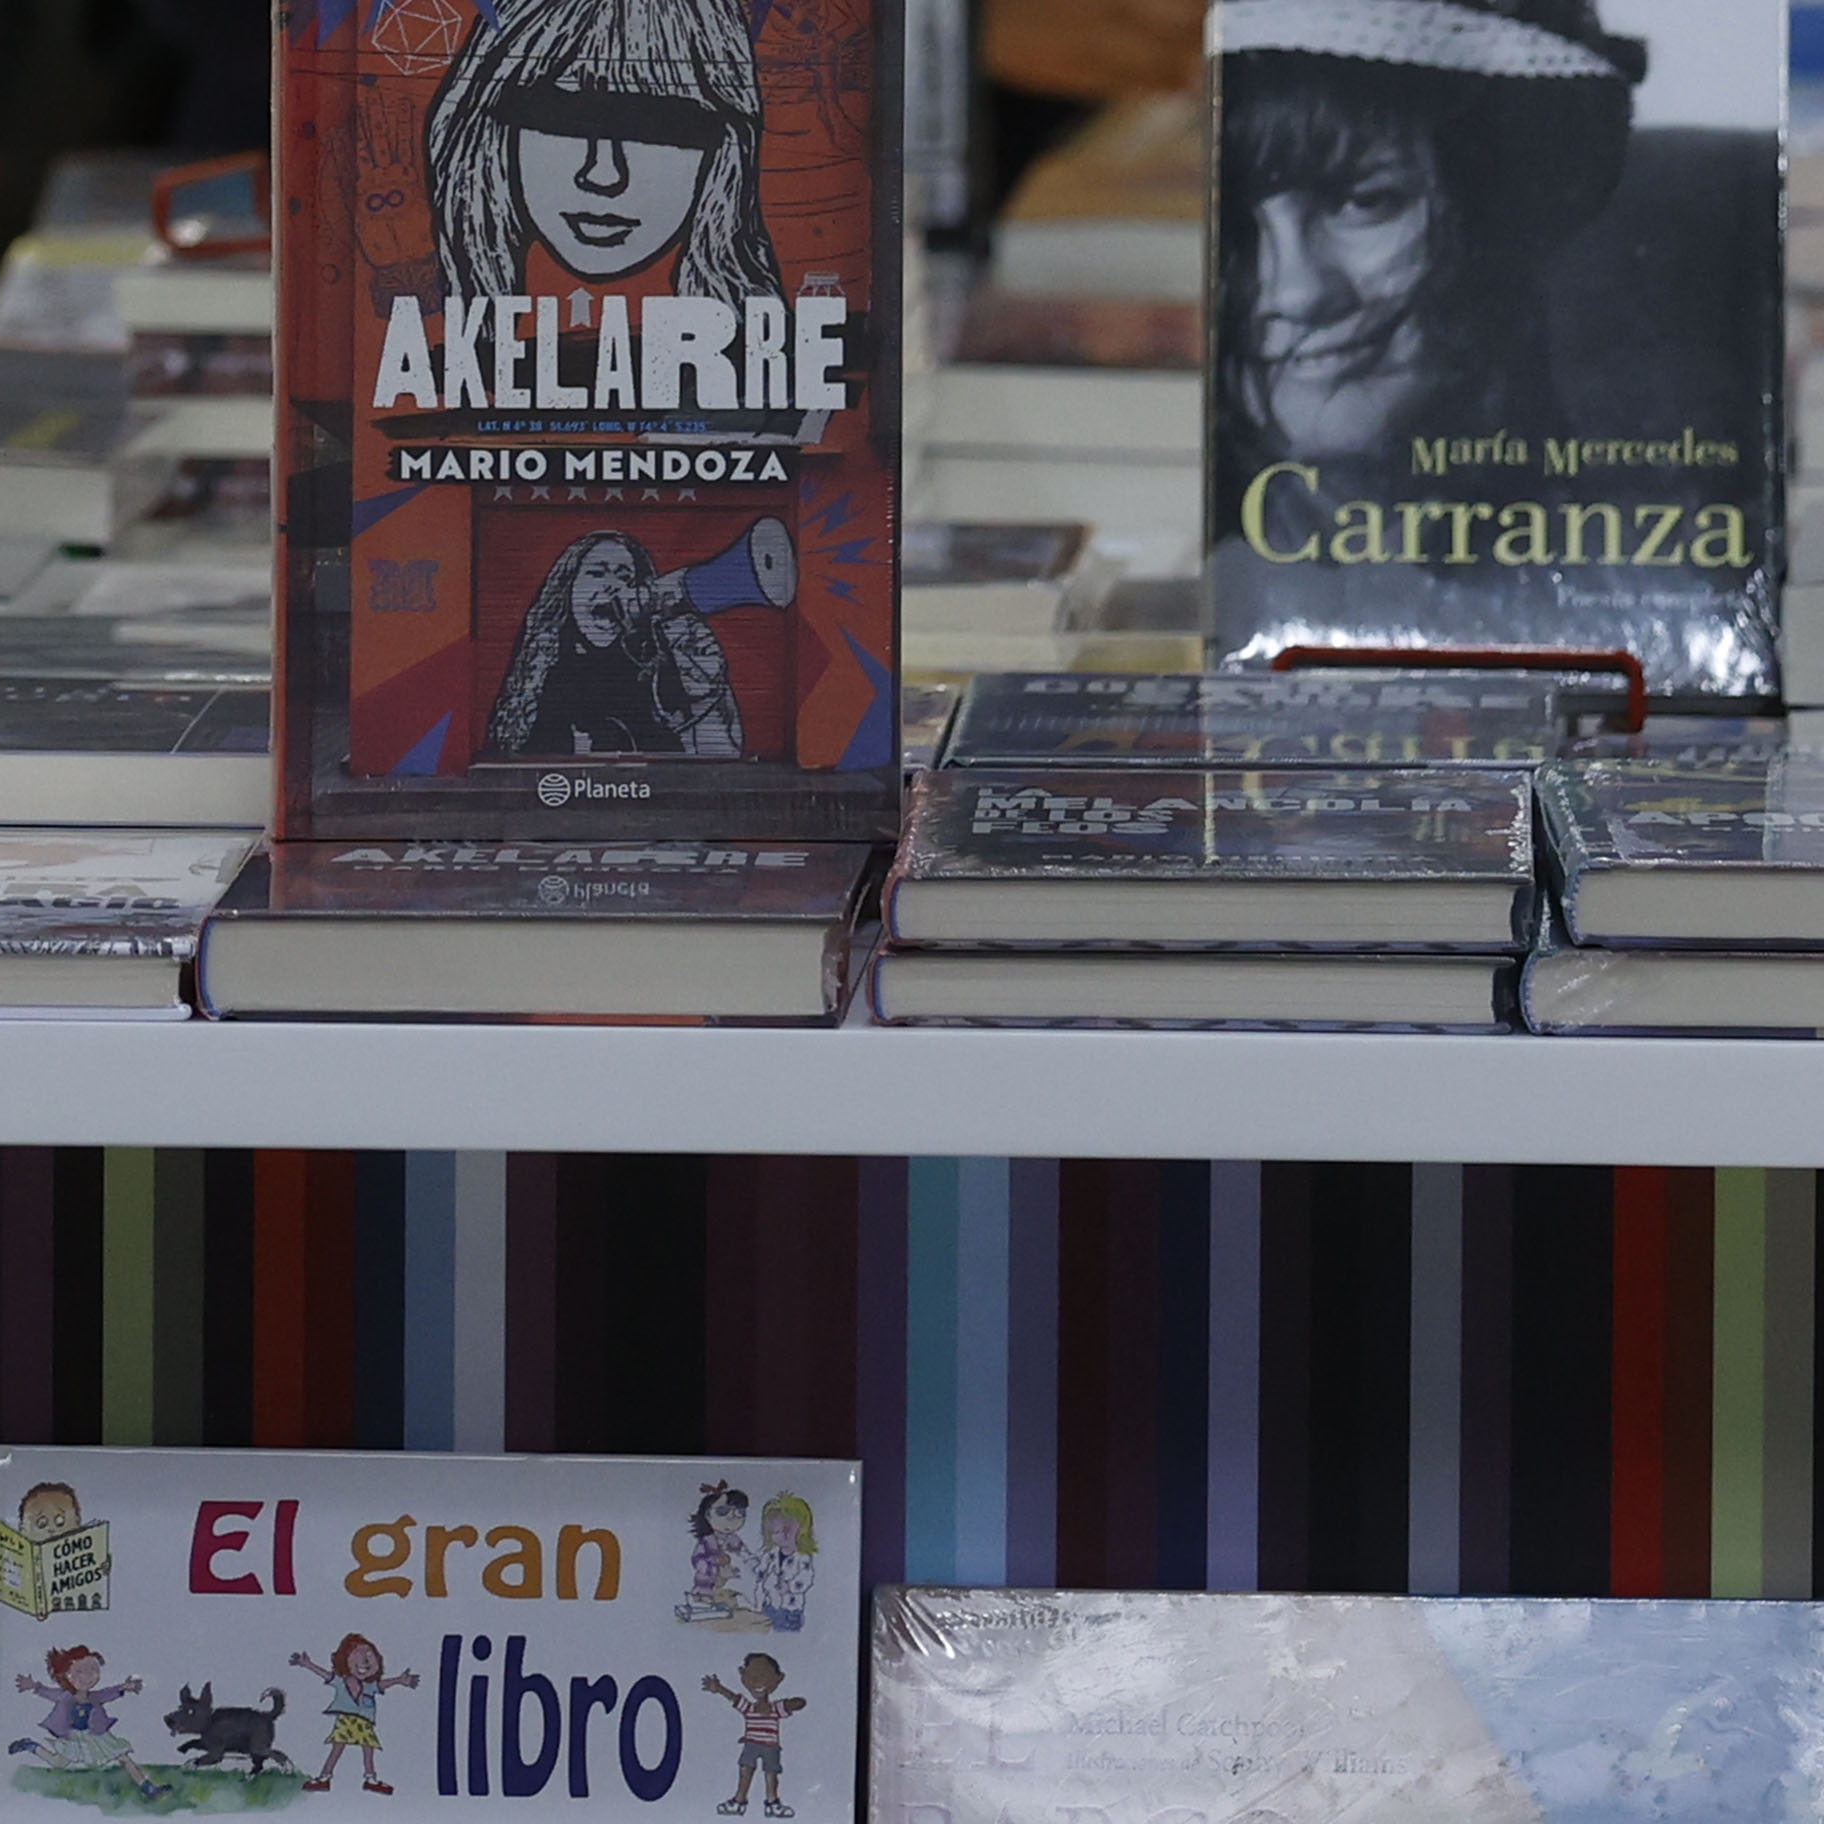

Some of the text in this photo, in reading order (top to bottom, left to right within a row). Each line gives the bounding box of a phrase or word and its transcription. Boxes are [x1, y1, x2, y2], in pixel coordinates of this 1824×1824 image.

[373, 294, 848, 412] AKELARRE
[399, 447, 789, 482] MARIO MENDOZA
[1412, 426, 1740, 477] María Mercedes
[1240, 462, 1754, 569] Carranza
[574, 777, 651, 798] Planeta
[975, 797, 1473, 812] MELANCOLIA
[972, 822, 1171, 834] FEOS
[331, 849, 809, 866] AKELARRE
[53, 1535, 93, 1559] CÓMO
[188, 1499, 622, 1601] El gran
[53, 1552, 97, 1578] HACER
[49, 1567, 103, 1597] AMIGOS
[436, 1633, 684, 1803] libro
